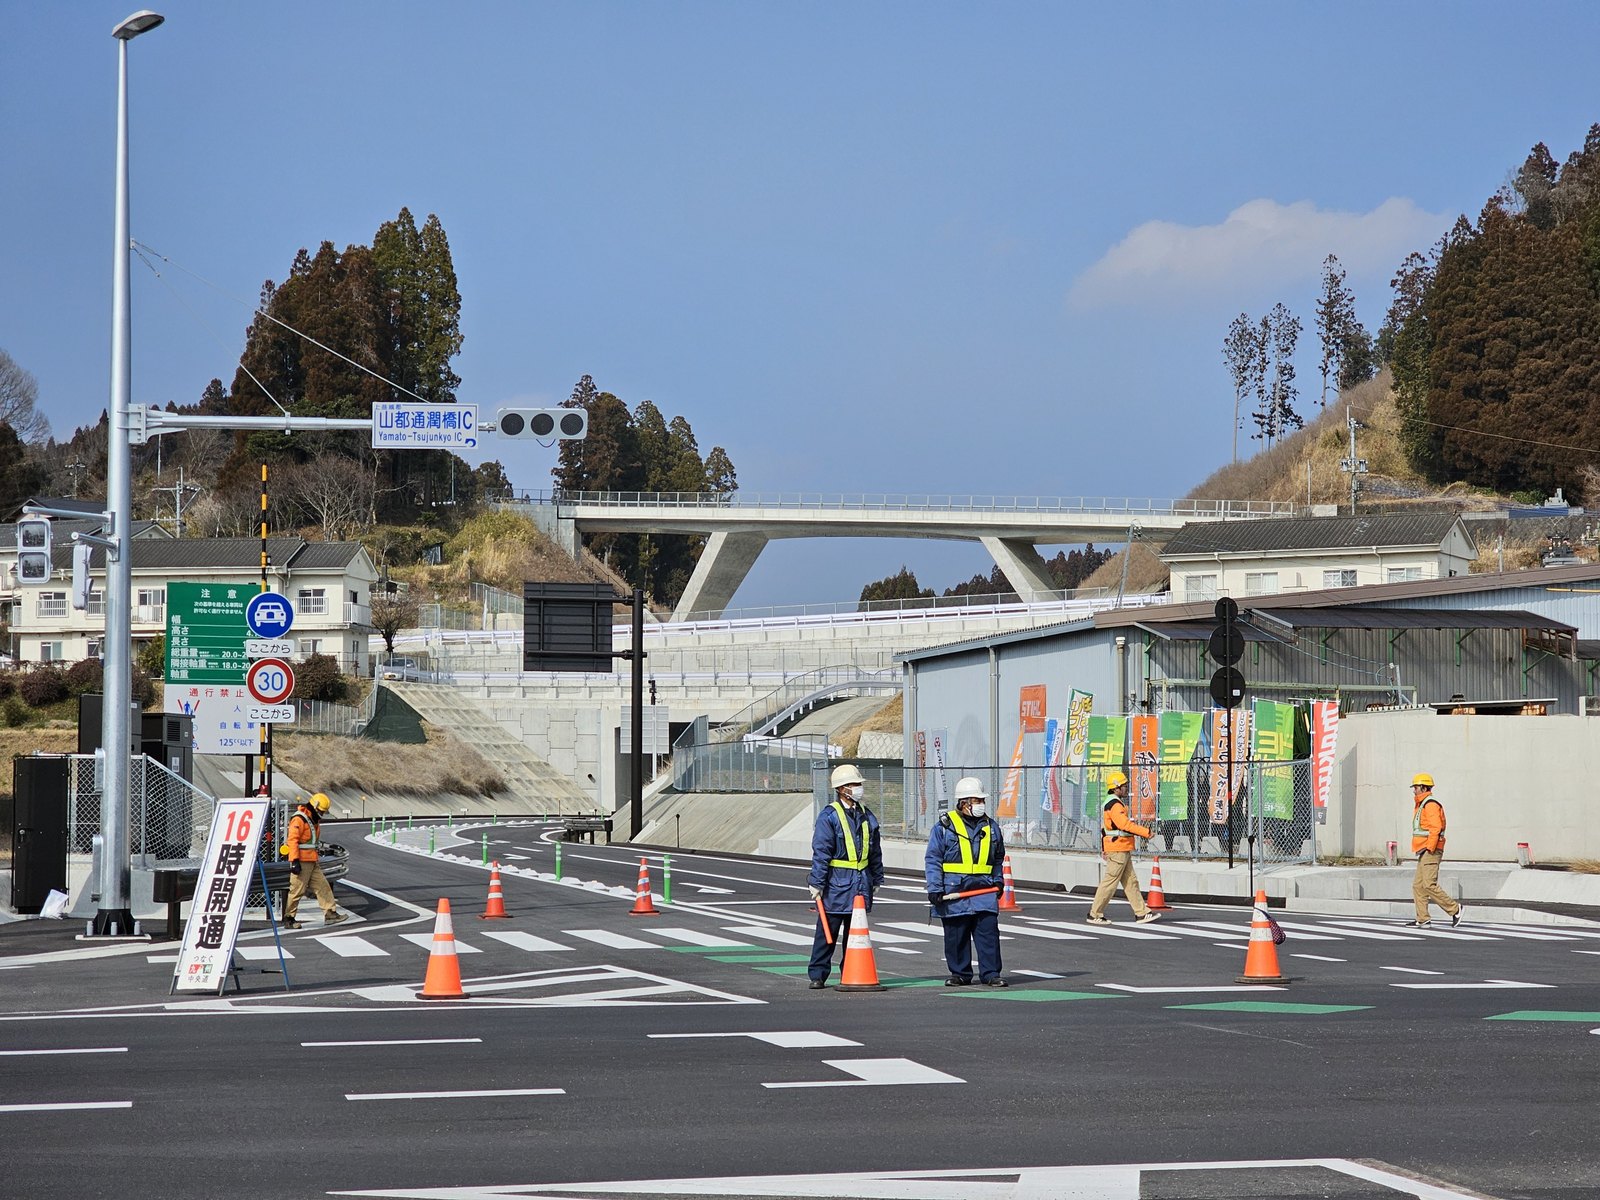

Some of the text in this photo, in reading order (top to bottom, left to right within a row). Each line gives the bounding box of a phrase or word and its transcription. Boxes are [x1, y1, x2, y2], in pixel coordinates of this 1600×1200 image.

[379, 411, 473, 430] 山都通潤橋IC
[378, 431, 462, 443] Yamato-Tsujunkyo IC
[171, 614, 181, 625] 幅
[171, 626, 189, 636] 高さ
[171, 637, 189, 647] 長さ
[170, 647, 198, 657] 総重量
[249, 644, 291, 653] ここから
[170, 658, 207, 668] 隣接軸重
[170, 669, 188, 679] 軸重
[258, 671, 283, 691] 30
[189, 687, 245, 698] 通行禁止
[233, 704, 241, 713] 人
[1021, 700, 1041, 717] STIHL
[250, 709, 292, 719] ここから
[219, 721, 255, 729] 自転車
[193, 955, 214, 963] つなぐ
[187, 975, 209, 984] 中央道
